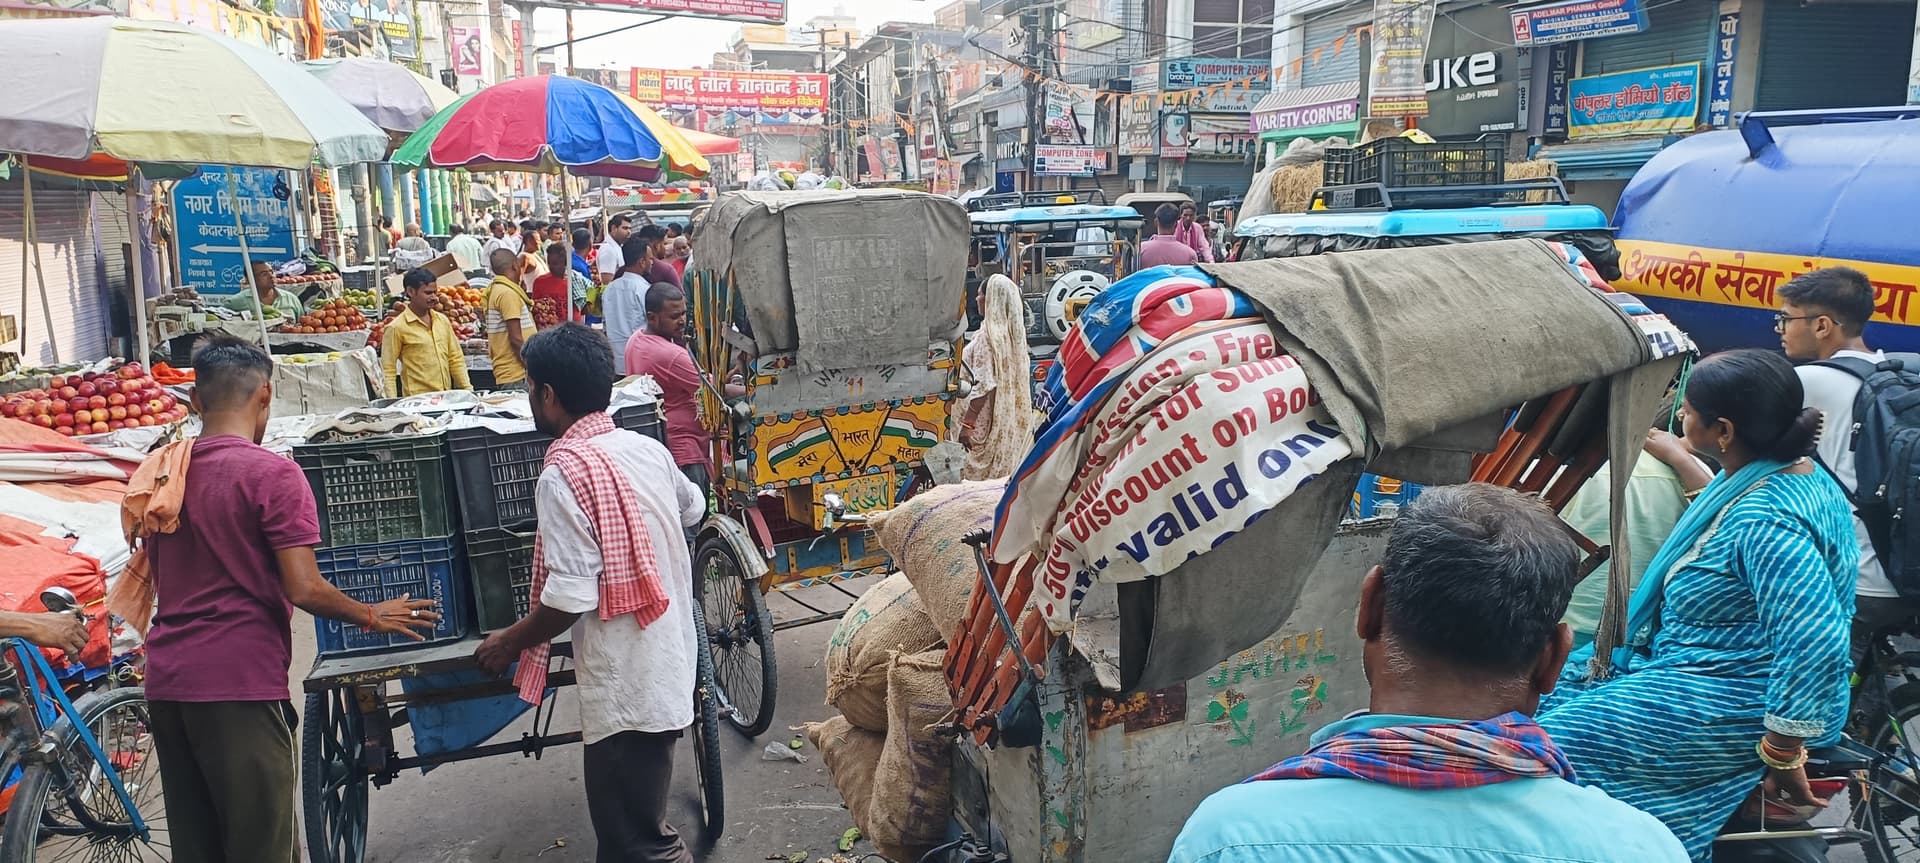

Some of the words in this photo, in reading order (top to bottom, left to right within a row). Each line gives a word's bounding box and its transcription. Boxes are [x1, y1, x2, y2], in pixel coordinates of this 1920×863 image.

[1533, 9, 1565, 19] ADELMAR
[1566, 4, 1597, 14] PHARMA
[1195, 64, 1243, 75] COMPUTER
[1247, 64, 1270, 76] ZONE
[1663, 81, 1693, 104] हॉल
[1256, 111, 1300, 131] VARIETY
[1302, 104, 1352, 125] CORNER
[1037, 149, 1074, 157] COMPUTER
[1217, 133, 1257, 154] CITY
[183, 195, 214, 215] नगर
[216, 190, 252, 215] निम
[1624, 249, 1711, 296] आपकी
[1715, 252, 1785, 307] सेवा
[1870, 281, 1918, 324] या
[1212, 331, 1276, 365] Fre
[1150, 382, 1204, 431] for
[1211, 354, 1295, 393] Sum
[841, 427, 872, 450] भारत
[1070, 432, 1209, 544] Discount
[1212, 406, 1258, 448] on
[1263, 384, 1322, 425] Boo
[1116, 462, 1250, 565] valid
[1257, 419, 1342, 480] onl
[1207, 627, 1337, 689] JAMIL
